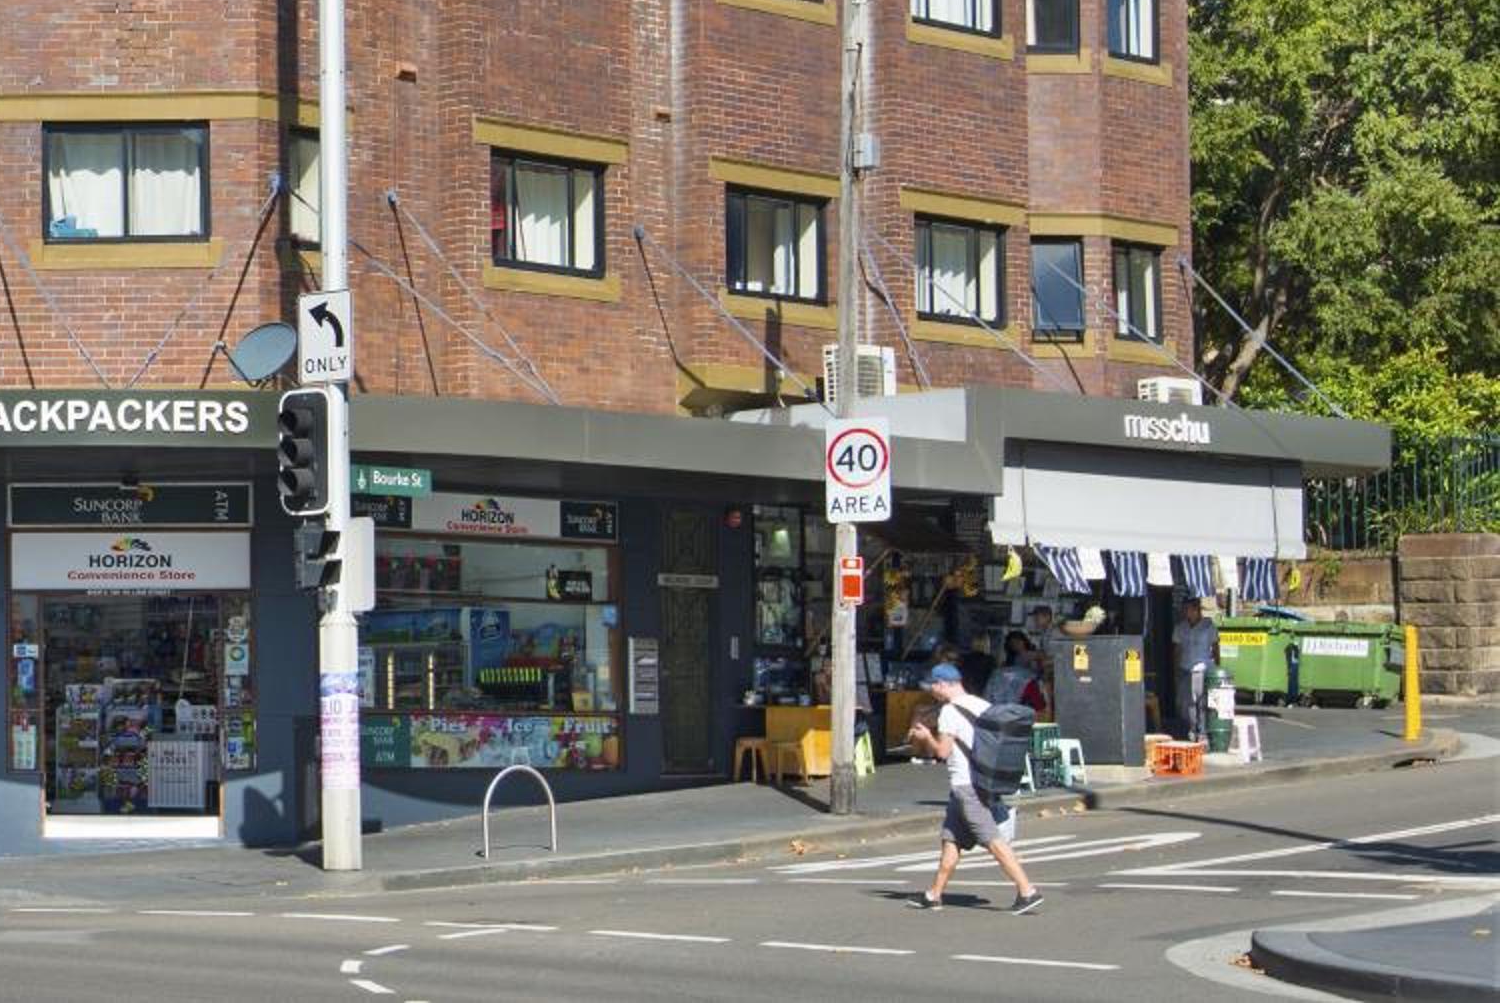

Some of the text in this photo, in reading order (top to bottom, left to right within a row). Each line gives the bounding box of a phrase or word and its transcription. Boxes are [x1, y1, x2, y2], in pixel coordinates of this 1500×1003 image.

[305, 356, 347, 373] ONLY
[1124, 413, 1211, 444] misschu
[836, 444, 878, 472] 40
[373, 471, 422, 487] Bourke St
[73, 498, 143, 512] SUNCORP
[215, 490, 229, 521] ATM
[831, 496, 887, 514] AREA
[101, 512, 141, 525] BANK
[461, 509, 515, 524] HORIZON
[89, 555, 172, 568] HORIZON
[67, 570, 196, 581] Convenience Store
[430, 718, 612, 734] Pies Ice Fruit
